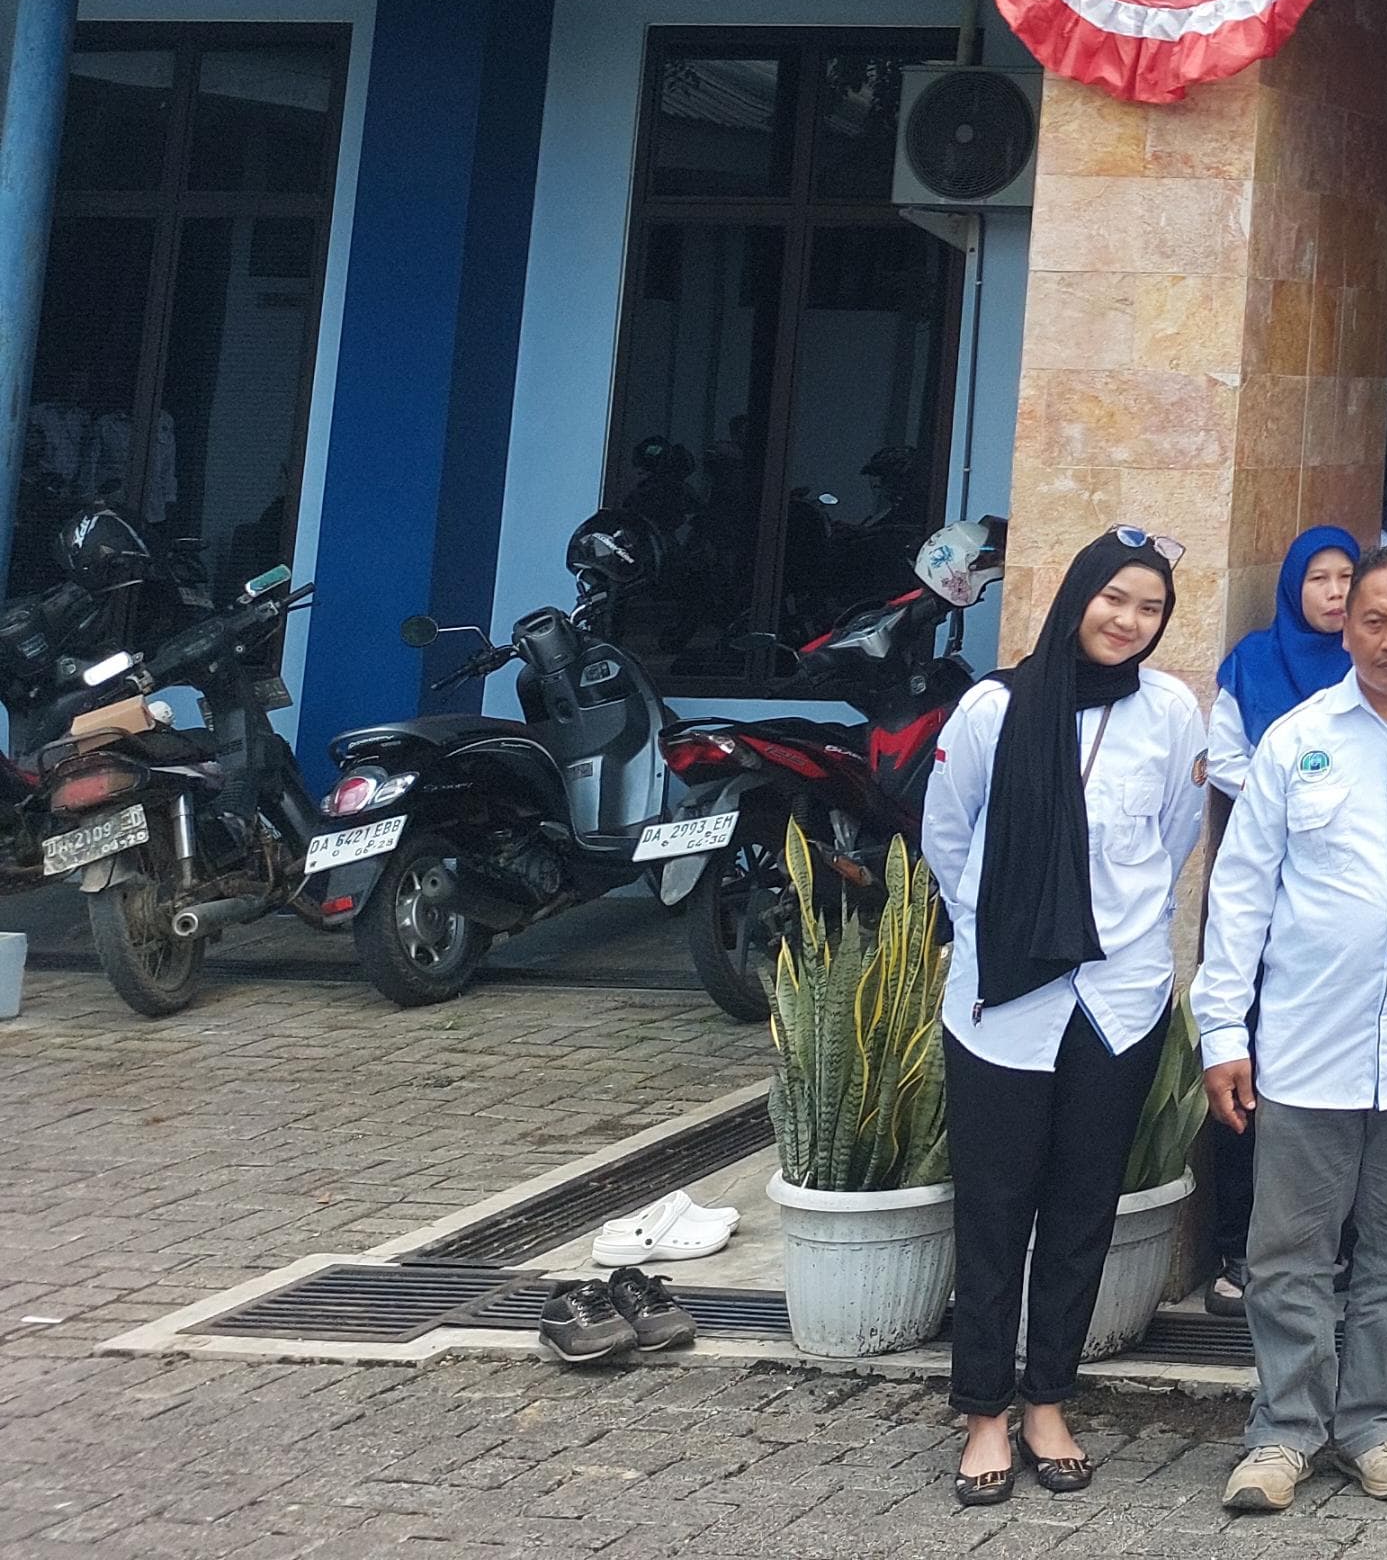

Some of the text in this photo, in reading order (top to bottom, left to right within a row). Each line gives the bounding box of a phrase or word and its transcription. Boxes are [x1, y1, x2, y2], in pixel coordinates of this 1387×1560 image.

[74, 822, 112, 850] 2109
[310, 819, 401, 854] DA 6421 EBB
[642, 828, 662, 844] DA
[670, 820, 705, 839] 2993
